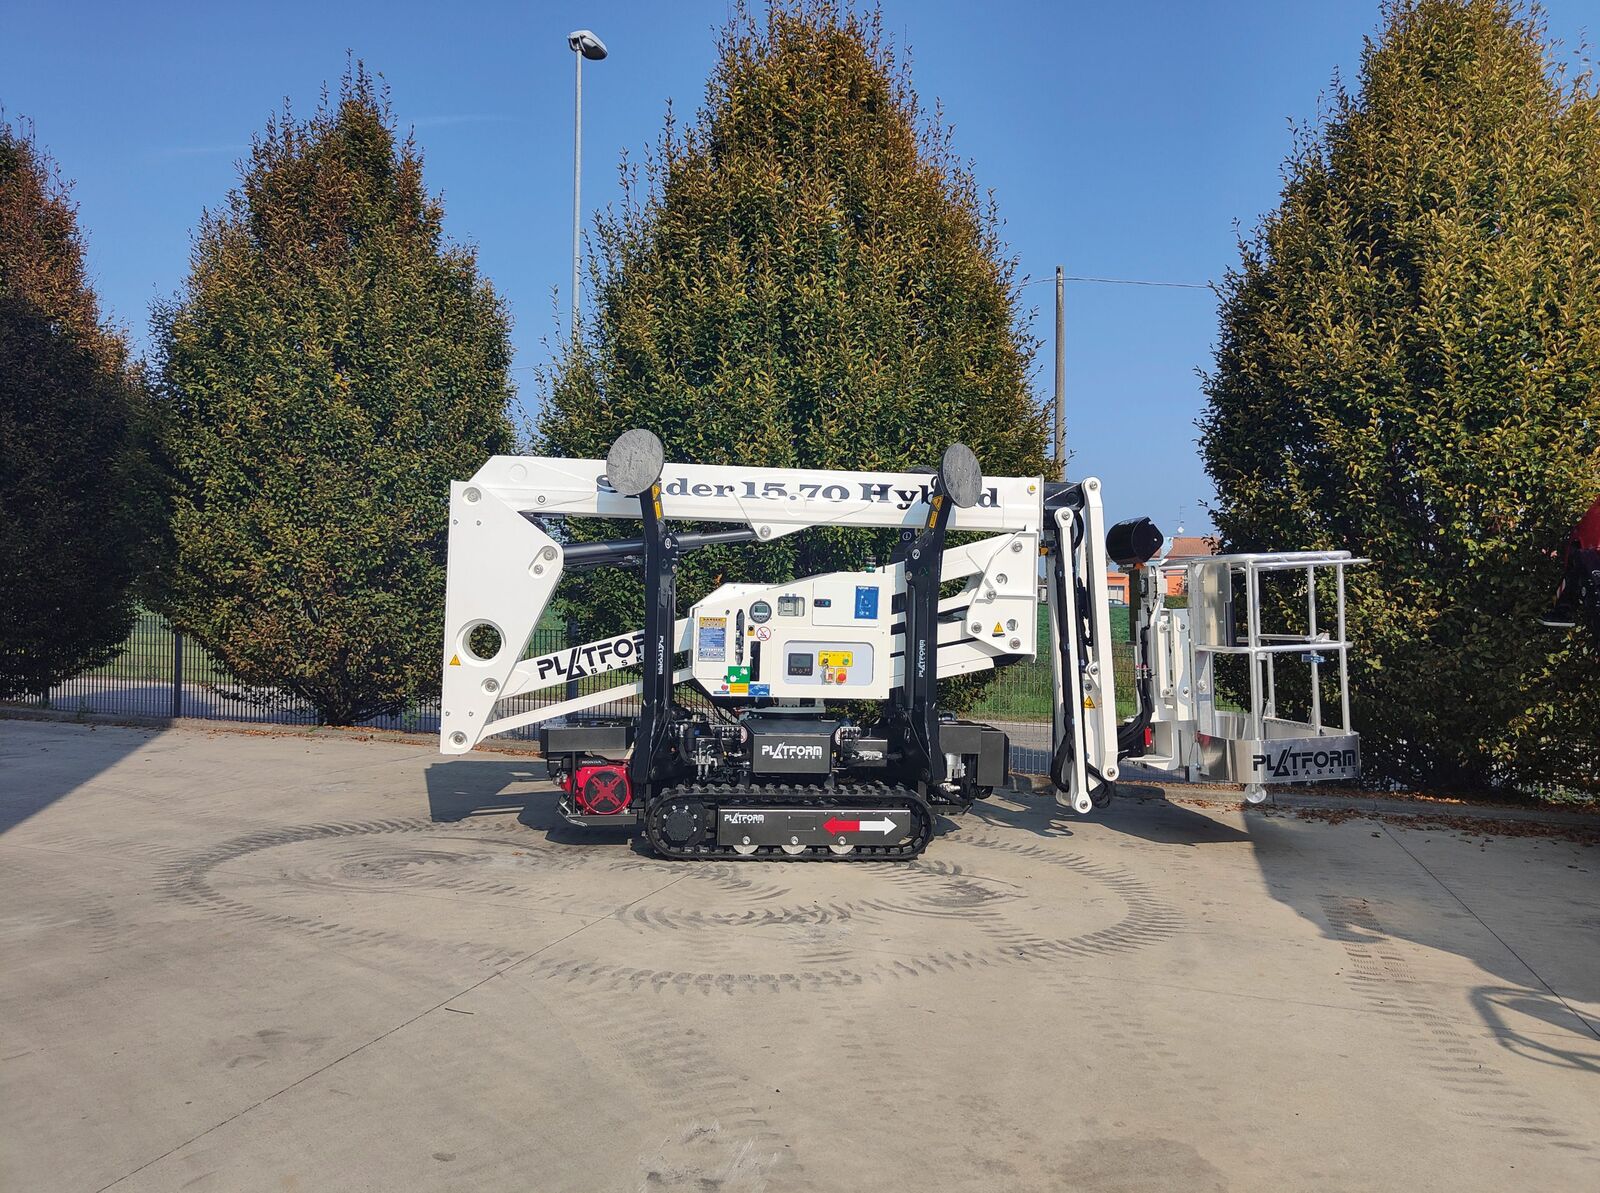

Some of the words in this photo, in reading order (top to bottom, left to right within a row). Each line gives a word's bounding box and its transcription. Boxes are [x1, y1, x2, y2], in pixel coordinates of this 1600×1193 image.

[740, 481, 850, 502] 15.70
[858, 482, 1001, 510] Hybd
[536, 633, 645, 681] PLATFOR
[591, 655, 645, 675] BASK
[761, 742, 823, 759] PLATFORM
[1252, 746, 1356, 777] PLATFORM
[1292, 766, 1356, 776] BASKET
[724, 811, 765, 824] PLATFORM
